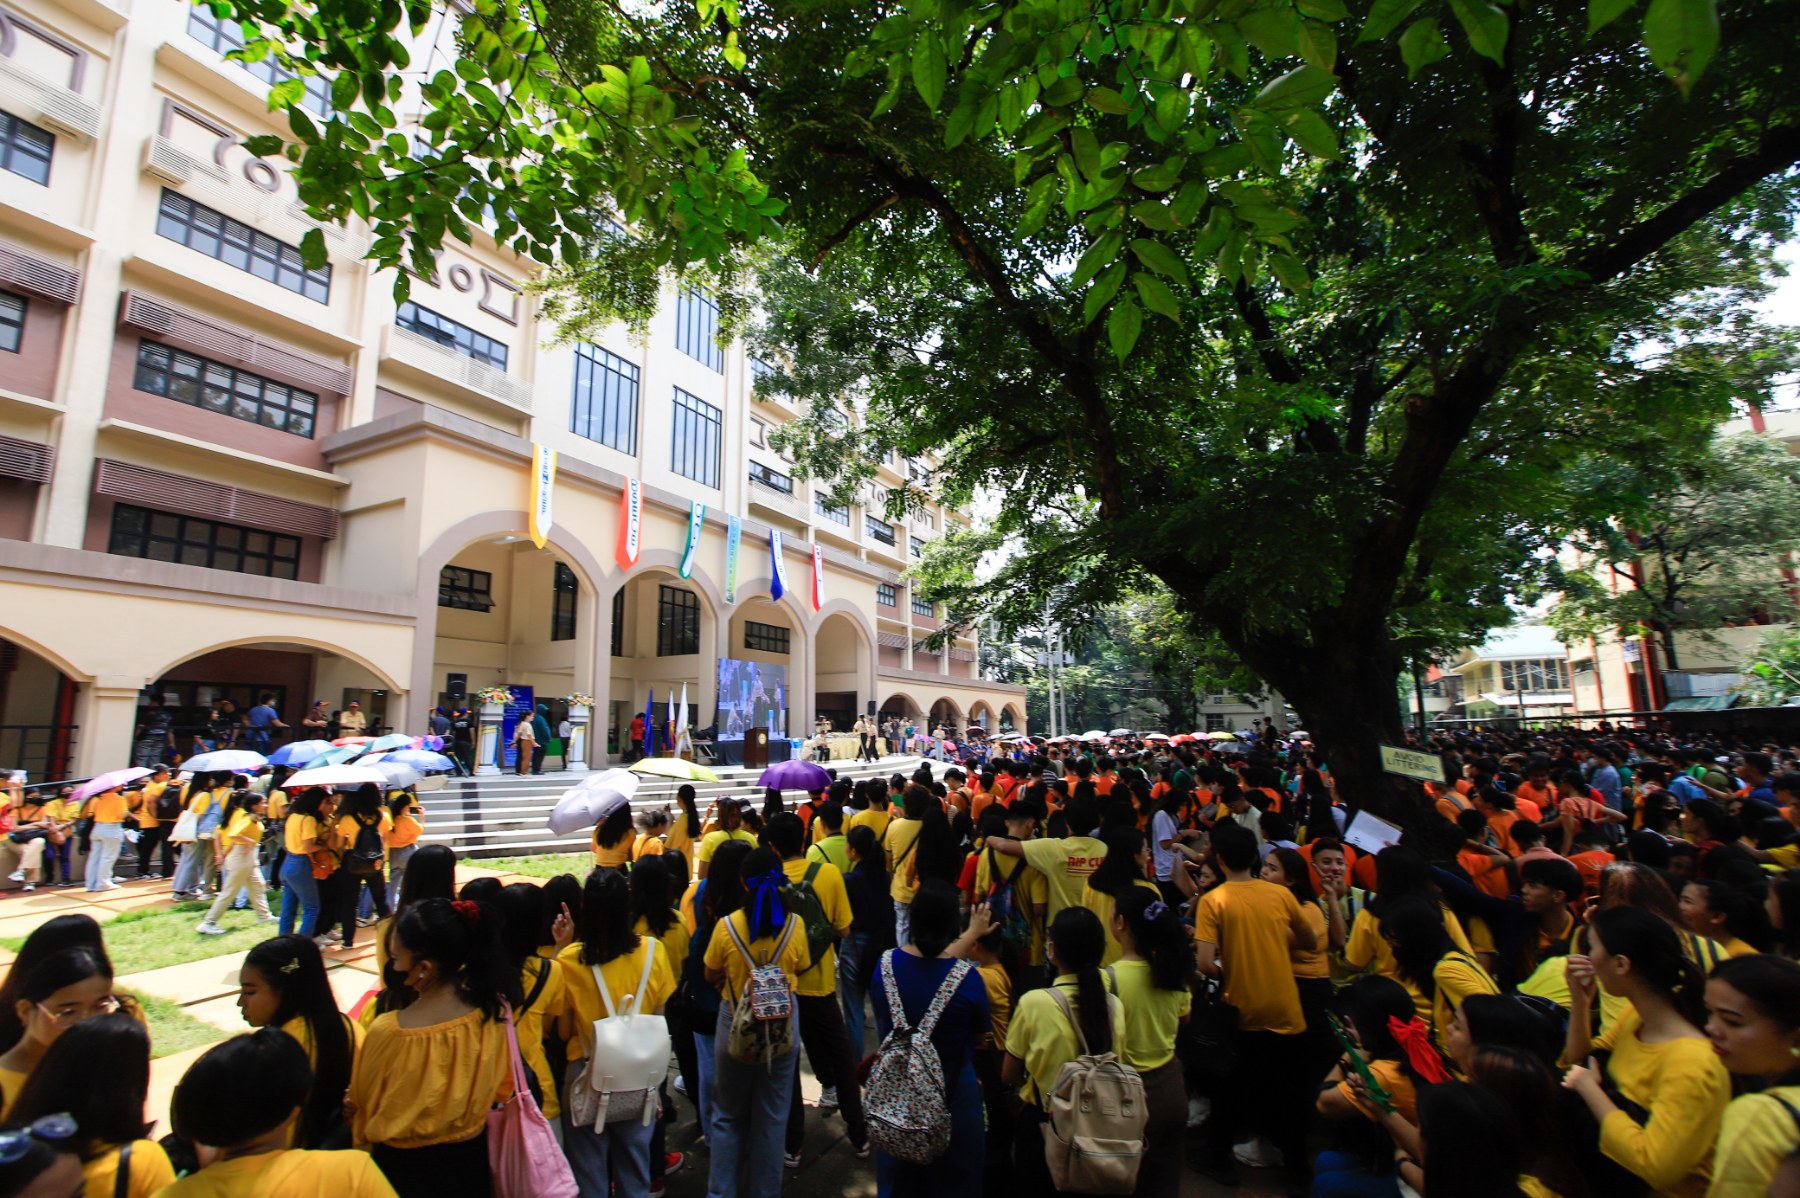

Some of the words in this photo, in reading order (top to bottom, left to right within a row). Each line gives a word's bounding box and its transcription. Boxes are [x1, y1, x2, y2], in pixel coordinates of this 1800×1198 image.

[1393, 751, 1424, 763] AVOID
[1386, 757, 1437, 773] LITTERING
[1067, 856, 1087, 868] RIP
[1088, 856, 1105, 868] CU
